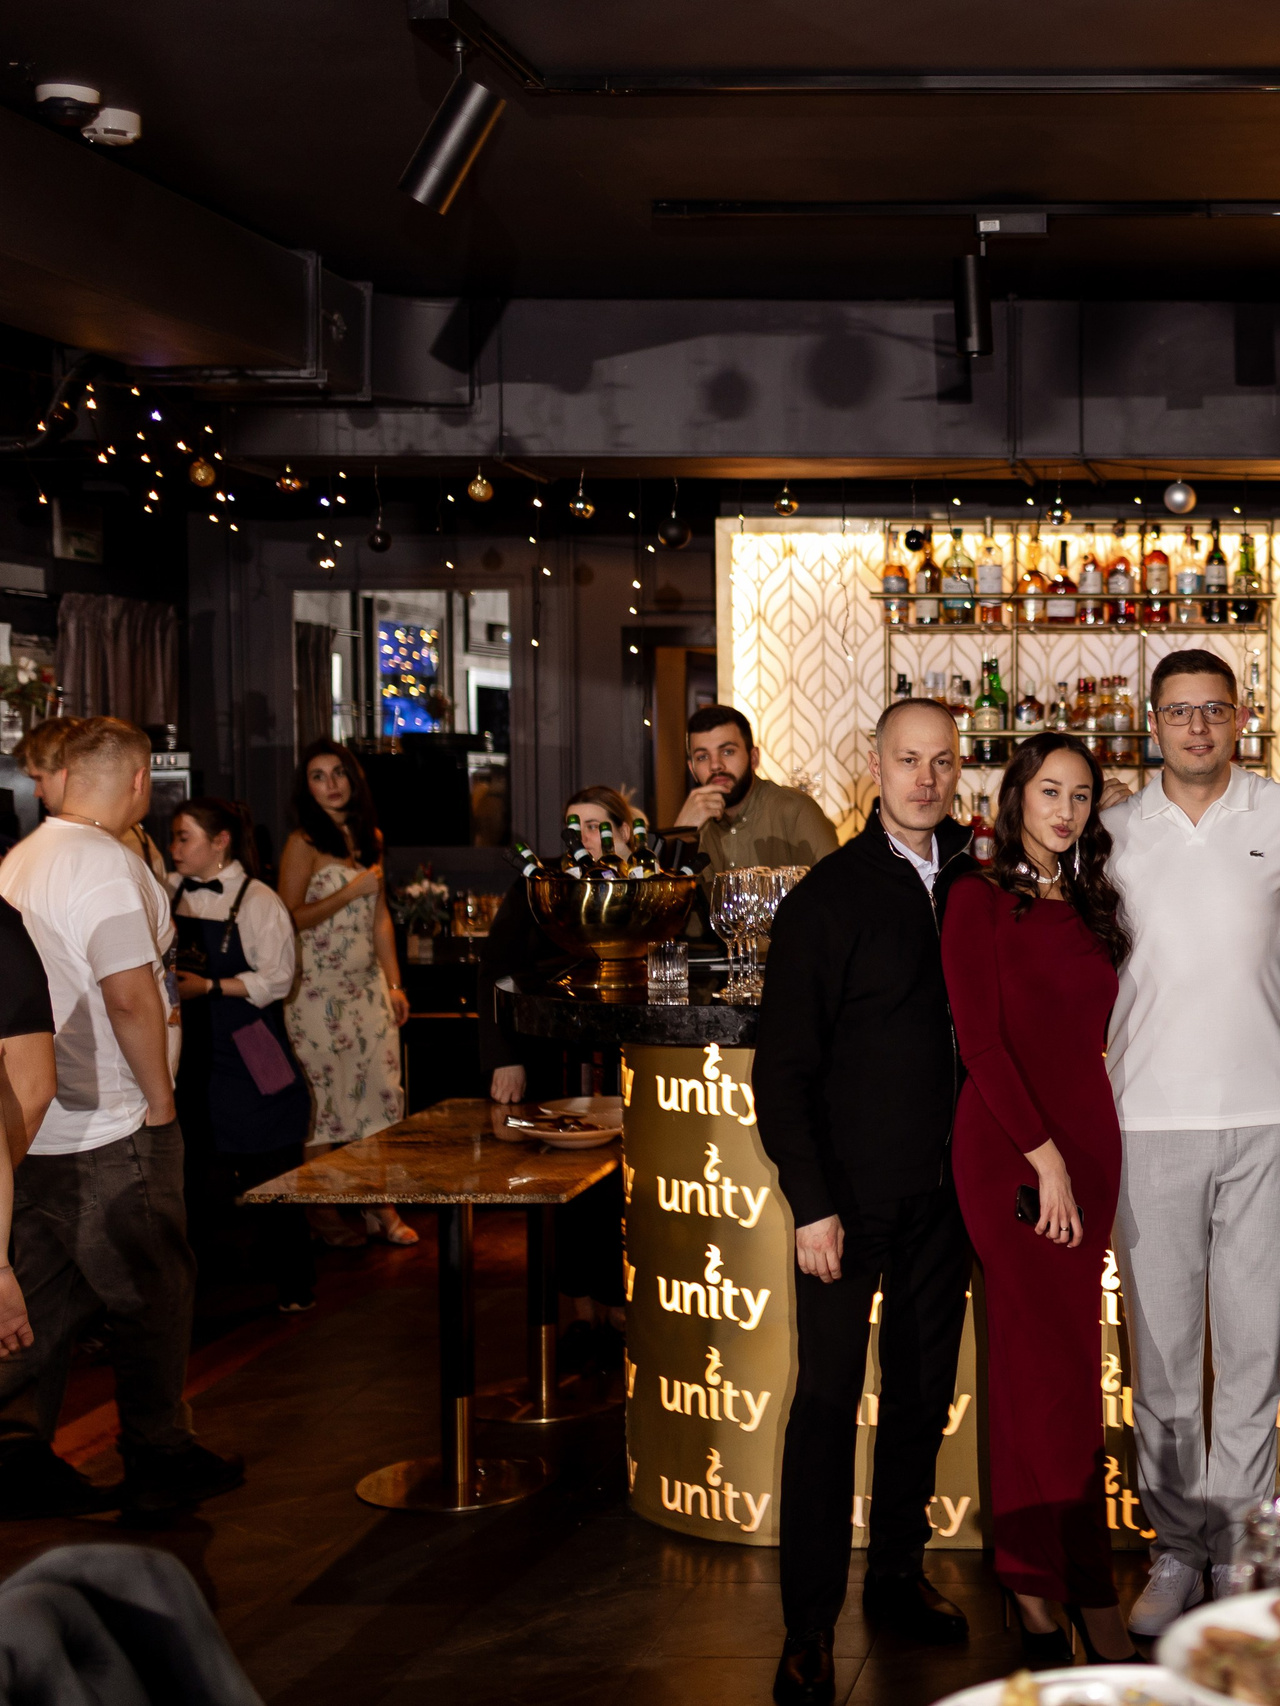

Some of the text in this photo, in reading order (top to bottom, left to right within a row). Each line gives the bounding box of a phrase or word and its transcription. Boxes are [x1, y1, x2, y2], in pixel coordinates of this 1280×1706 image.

[655, 1042, 758, 1127] unity
[656, 1142, 770, 1229] unity
[656, 1243, 772, 1331] unity
[659, 1345, 772, 1433] unity
[660, 1447, 772, 1533] unity
